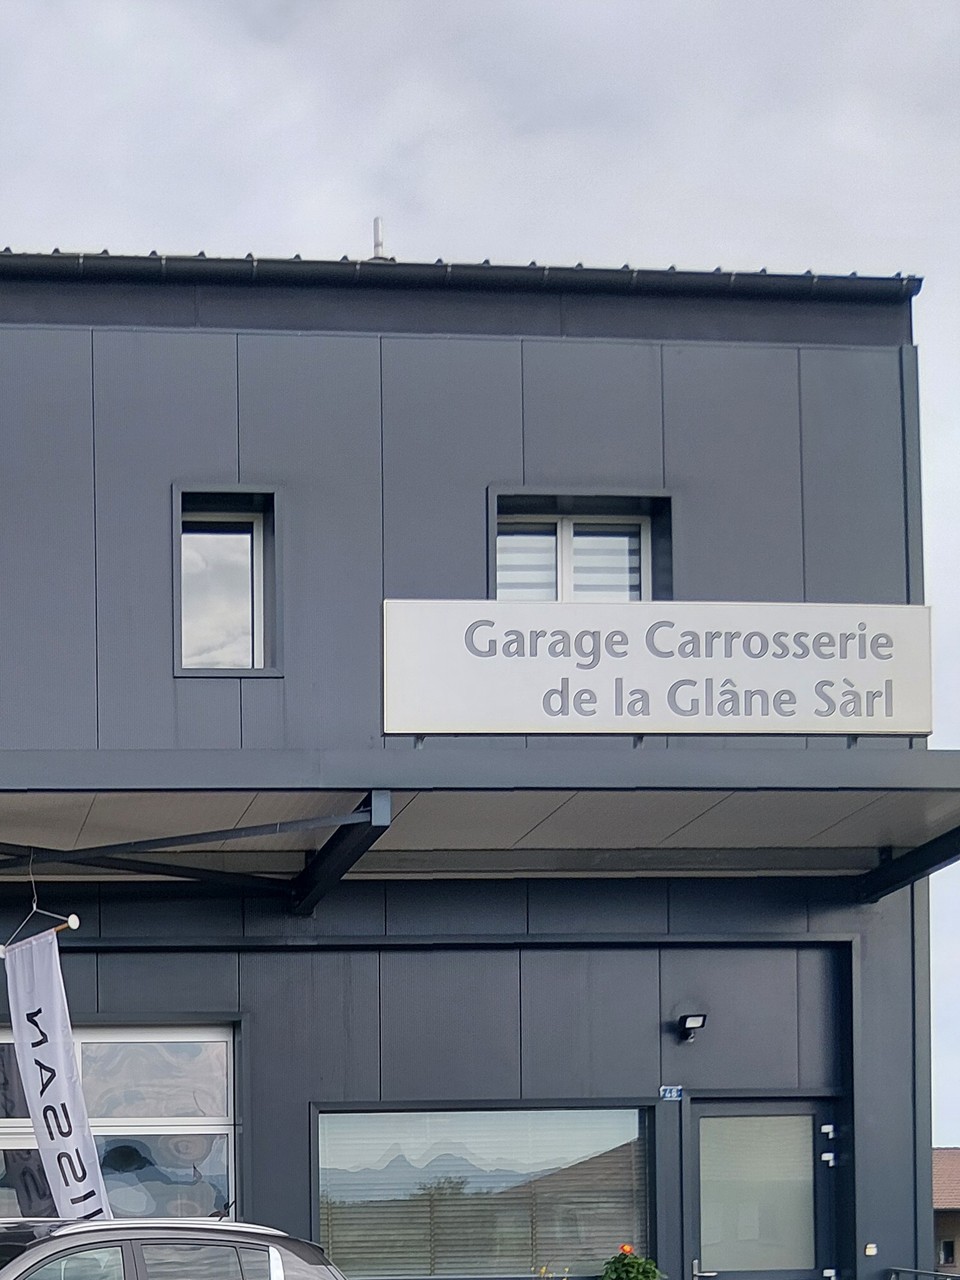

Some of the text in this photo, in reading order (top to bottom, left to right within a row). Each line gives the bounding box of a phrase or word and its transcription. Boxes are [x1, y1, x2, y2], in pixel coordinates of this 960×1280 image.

[464, 619, 895, 669] Garage Carrosserie
[541, 677, 894, 718] de la Glâne Sàrl
